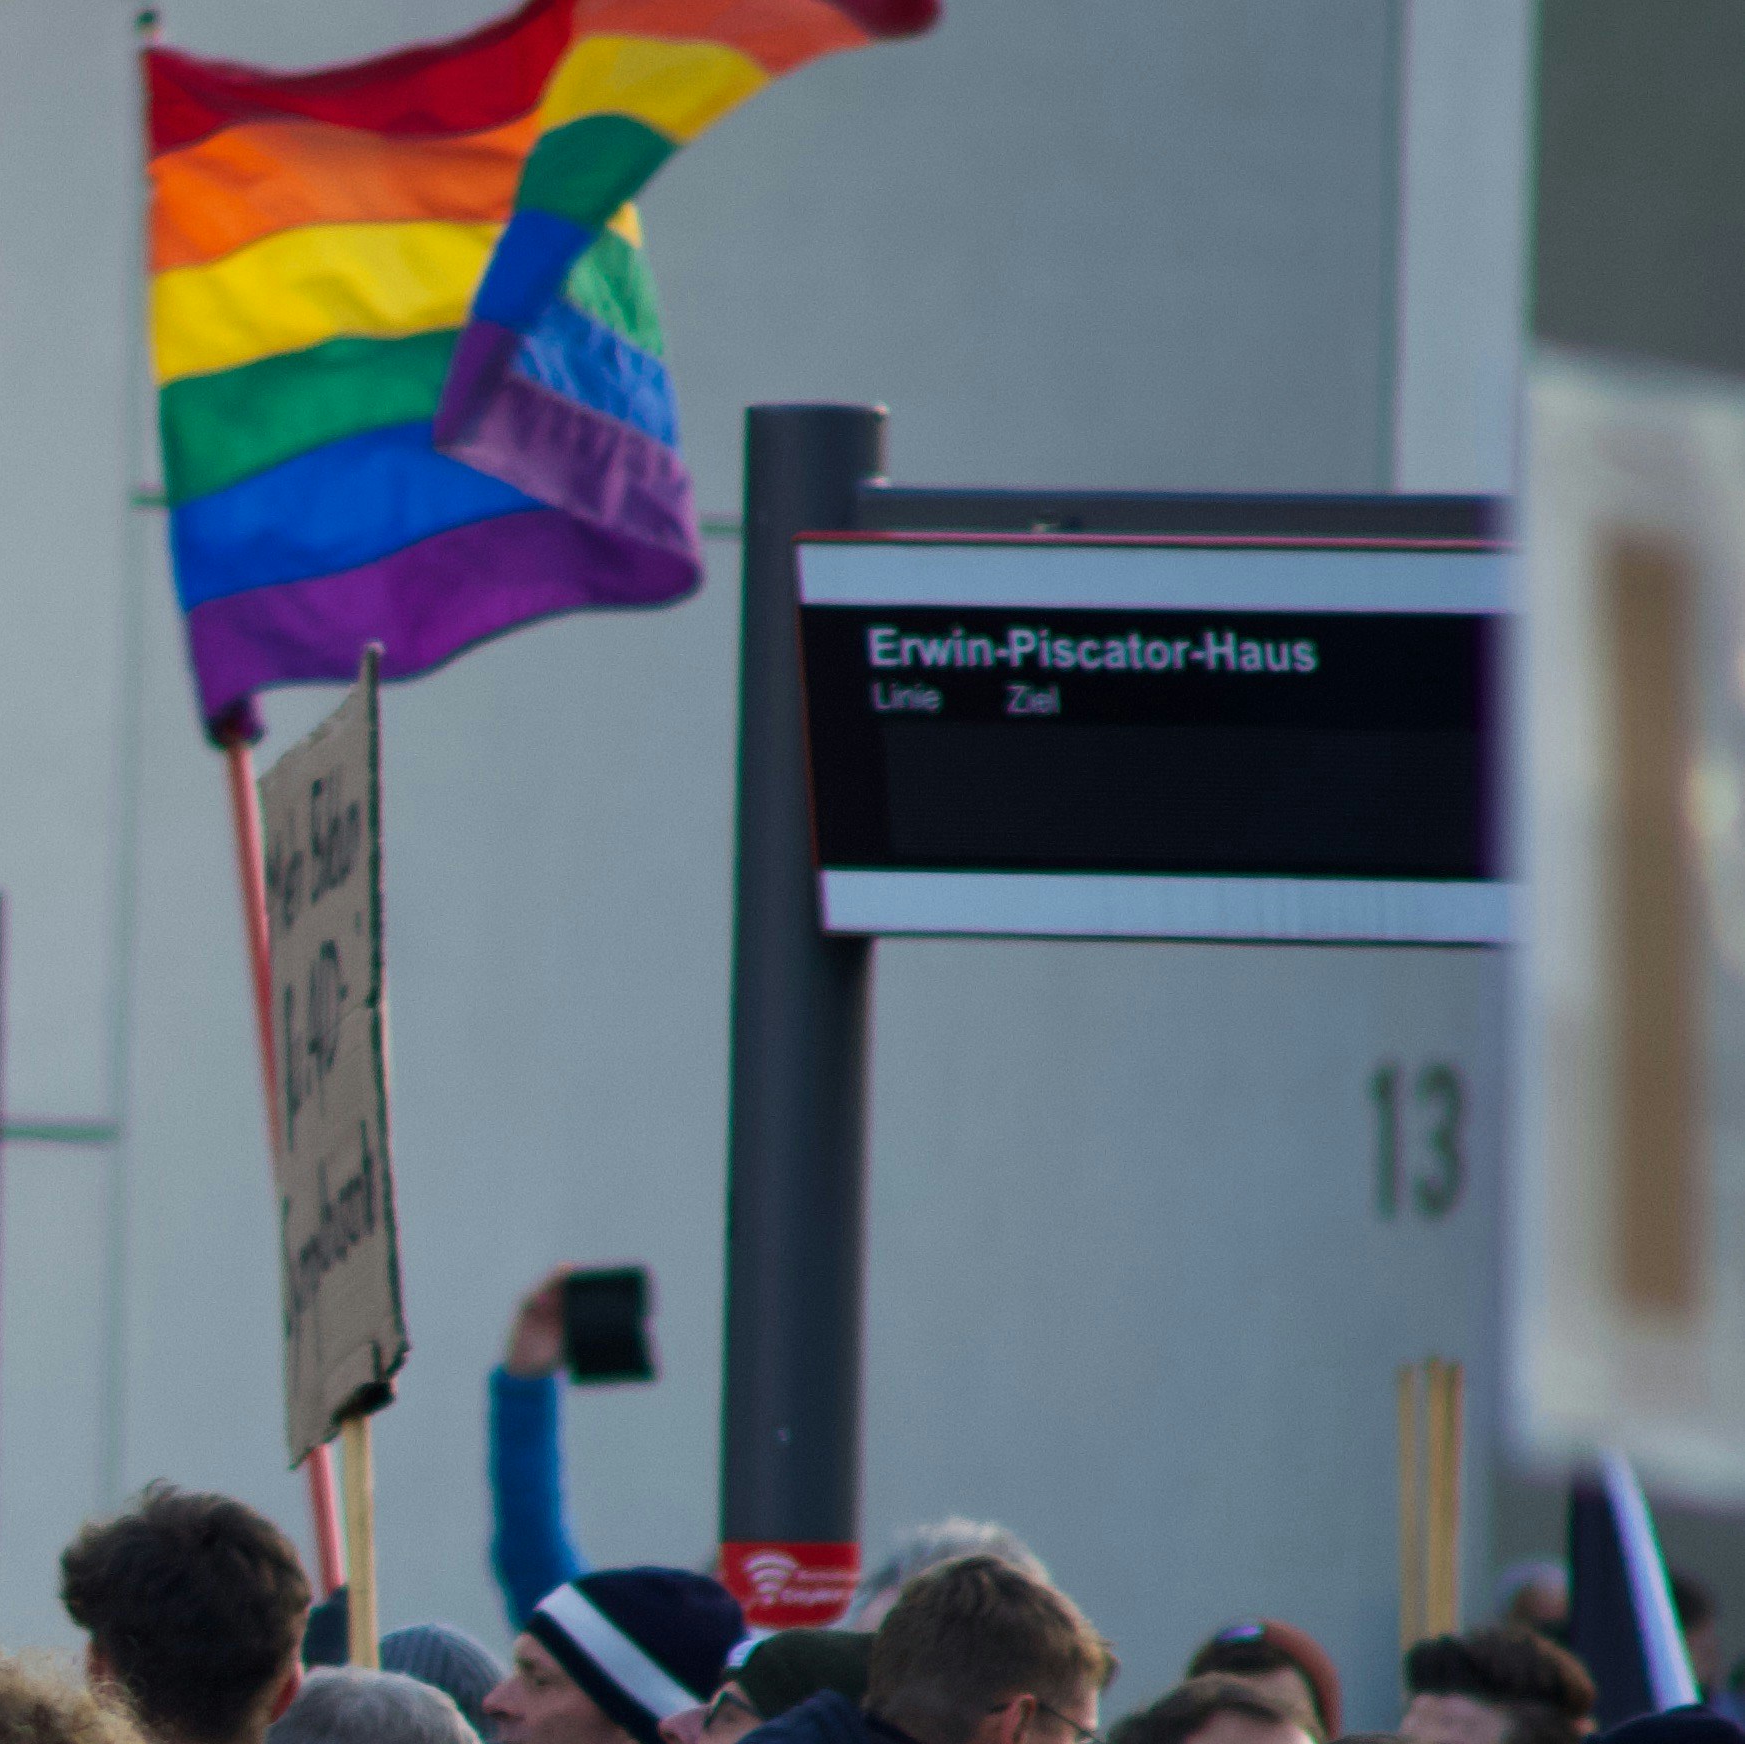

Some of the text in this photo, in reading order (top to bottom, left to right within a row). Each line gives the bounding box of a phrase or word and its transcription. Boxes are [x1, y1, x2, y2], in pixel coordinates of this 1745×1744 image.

[867, 626, 1318, 673] Erwin-Piscator-Haus
[872, 682, 1062, 715] Linie Ziel
[1367, 1062, 1469, 1222] 13
